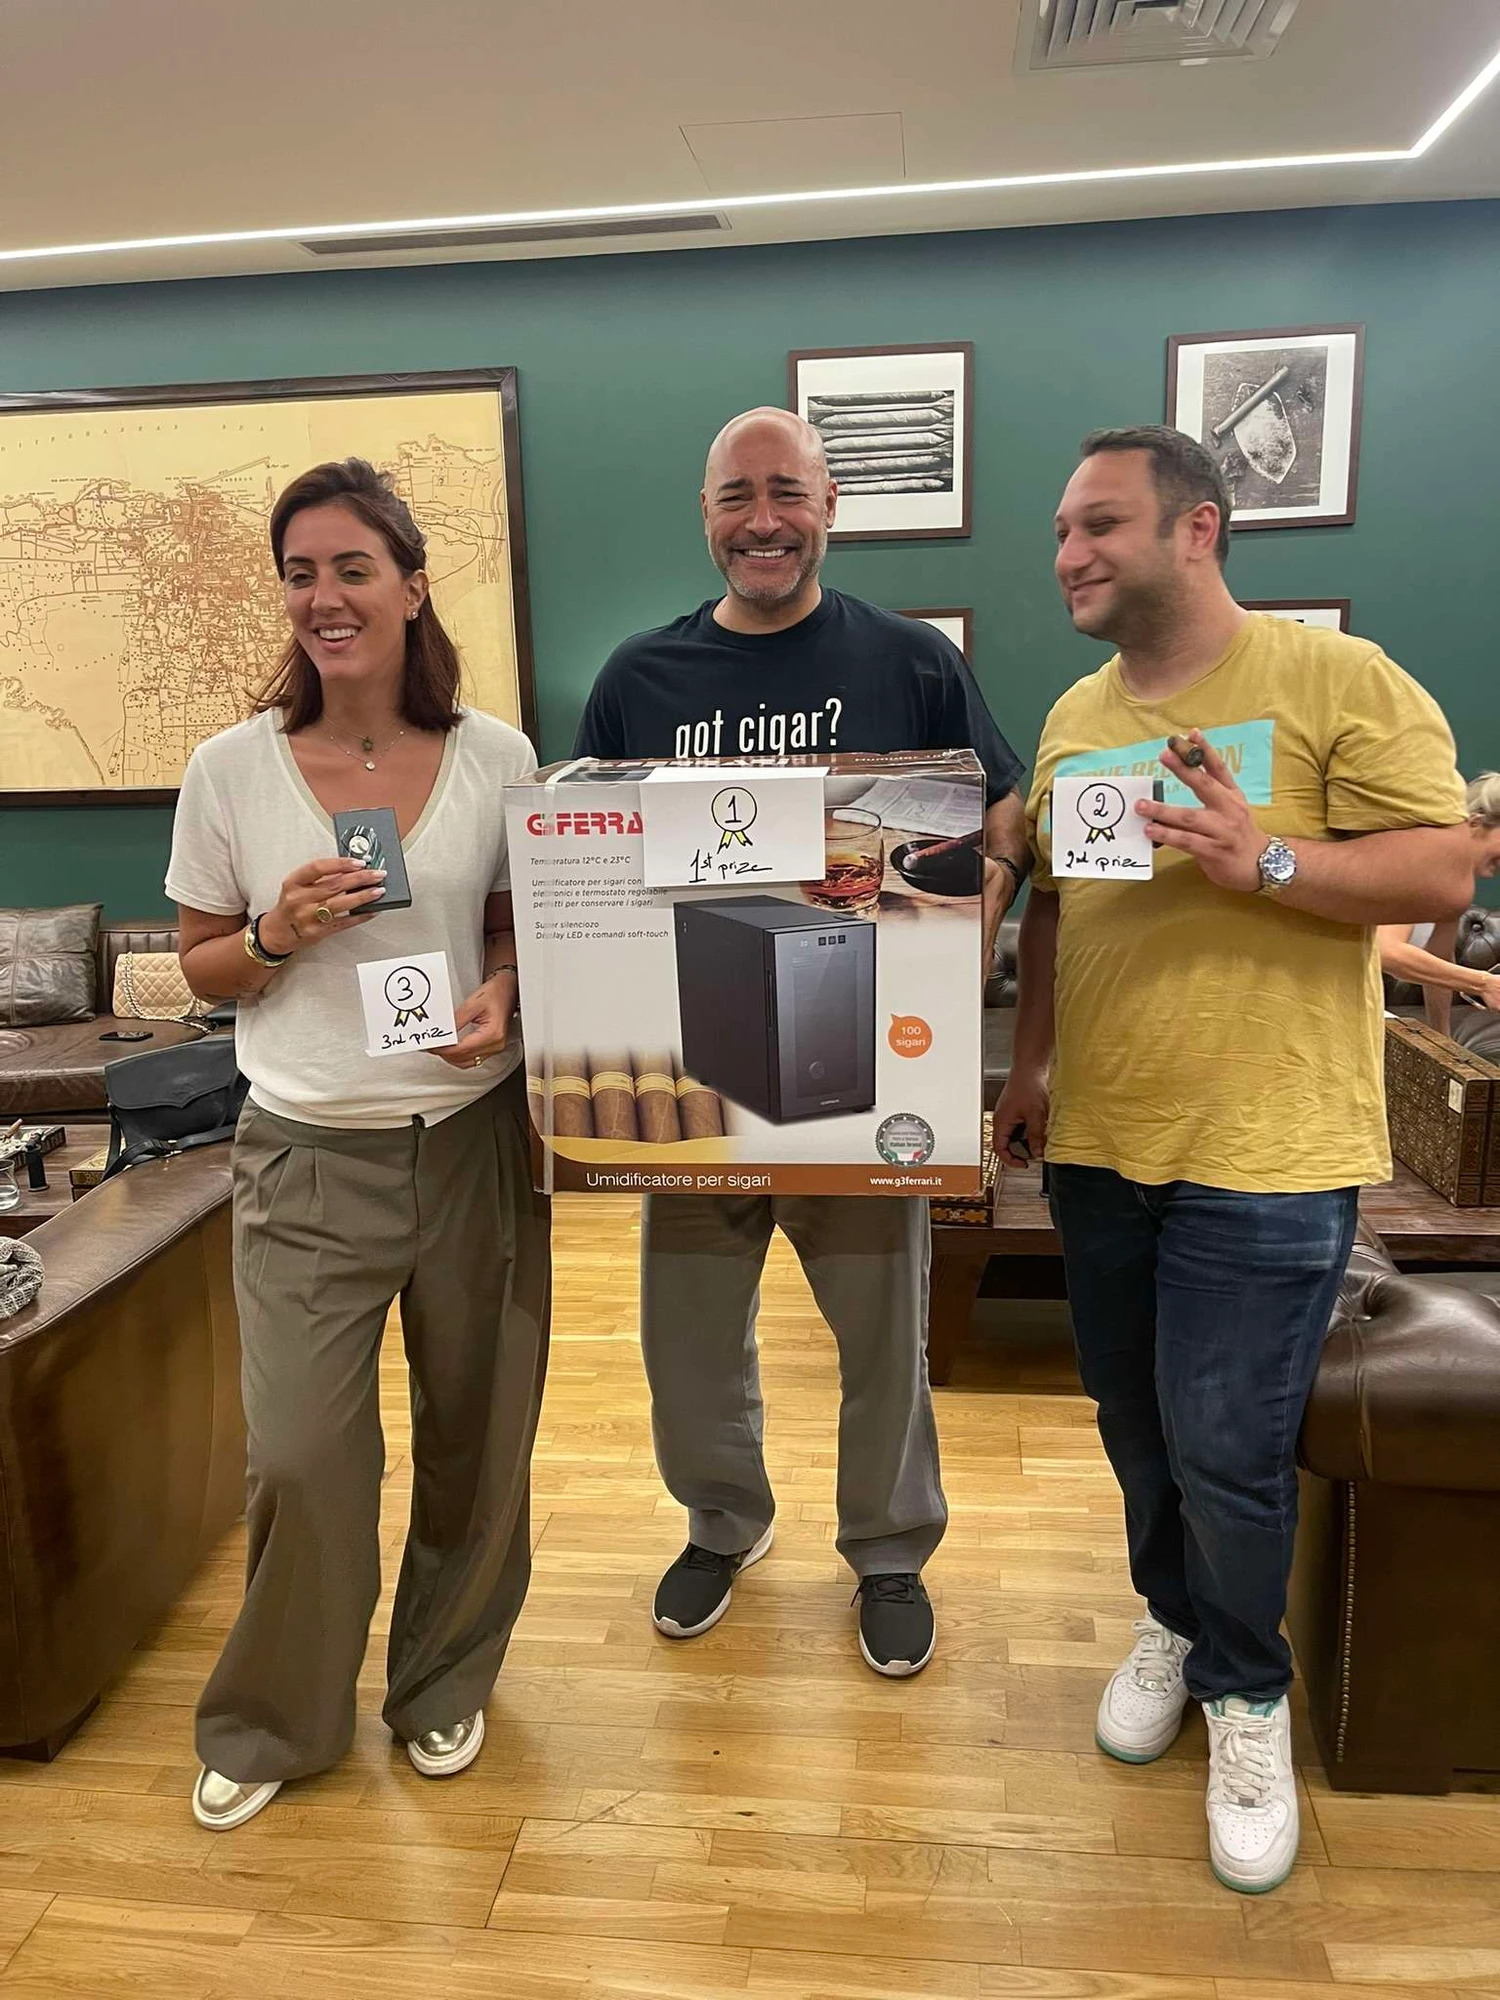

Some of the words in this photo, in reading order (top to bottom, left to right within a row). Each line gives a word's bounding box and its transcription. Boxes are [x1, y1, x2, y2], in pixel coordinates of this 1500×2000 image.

[676, 709, 724, 759] got
[738, 697, 842, 756] cigar?
[725, 795, 742, 823] 1
[1093, 792, 1108, 818] 2
[530, 857, 580, 866] Temratura
[688, 849, 713, 883] 1st
[718, 861, 773, 880] prize
[1066, 850, 1089, 869] 2nd
[1095, 856, 1151, 871] prize
[532, 878, 586, 887] Umificatore
[588, 880, 601, 888] per
[603, 878, 625, 888] sigari
[627, 878, 642, 886] con
[533, 888, 573, 898] eleonici
[582, 888, 626, 897] termostato
[533, 899, 563, 909] petti
[581, 899, 625, 907] conservare
[631, 899, 653, 908] sigari
[535, 921, 558, 930] Sur
[536, 931, 564, 940] Dilay
[566, 931, 583, 940] LED
[591, 930, 626, 939] comandi
[627, 930, 669, 939] soft-touch
[397, 976, 414, 1001] 3
[409, 1027, 453, 1045] prize
[902, 1026, 921, 1035] 100
[896, 1037, 926, 1048] sigari
[586, 1172, 693, 1187] Umidificatore
[697, 1174, 723, 1189] per
[727, 1172, 771, 1189] sigari
[870, 1175, 942, 1187] www.g3ferrari.it
